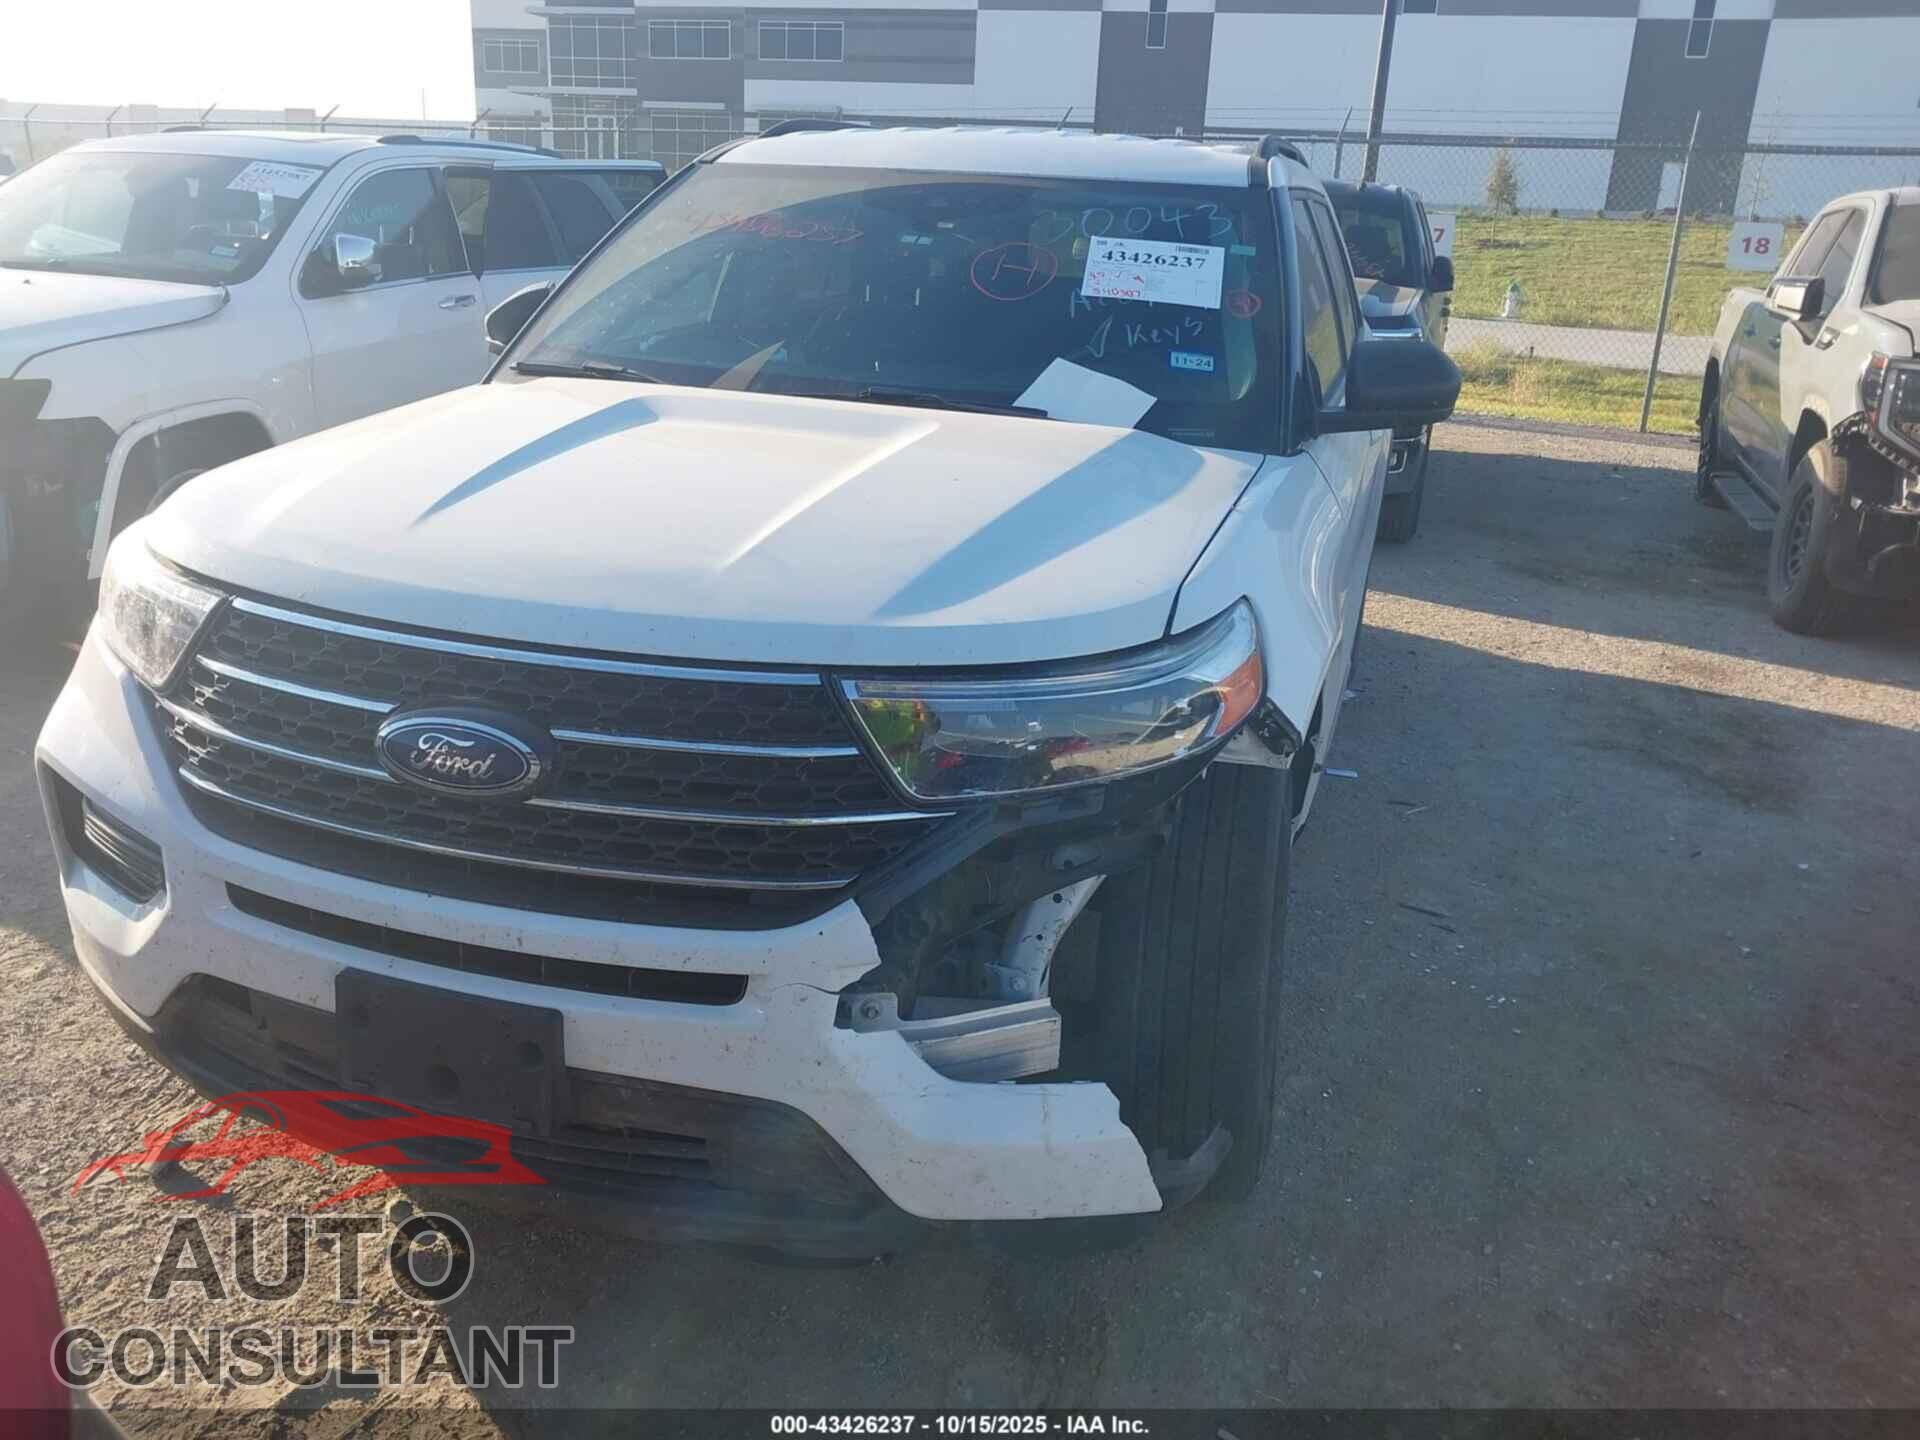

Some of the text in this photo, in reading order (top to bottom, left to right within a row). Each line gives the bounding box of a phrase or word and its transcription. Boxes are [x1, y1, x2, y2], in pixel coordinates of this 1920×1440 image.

[1433, 228, 1445, 243] 7
[1740, 236, 1771, 255] 18
[1102, 249, 1206, 269] 43426237
[411, 732, 497, 779] Ford
